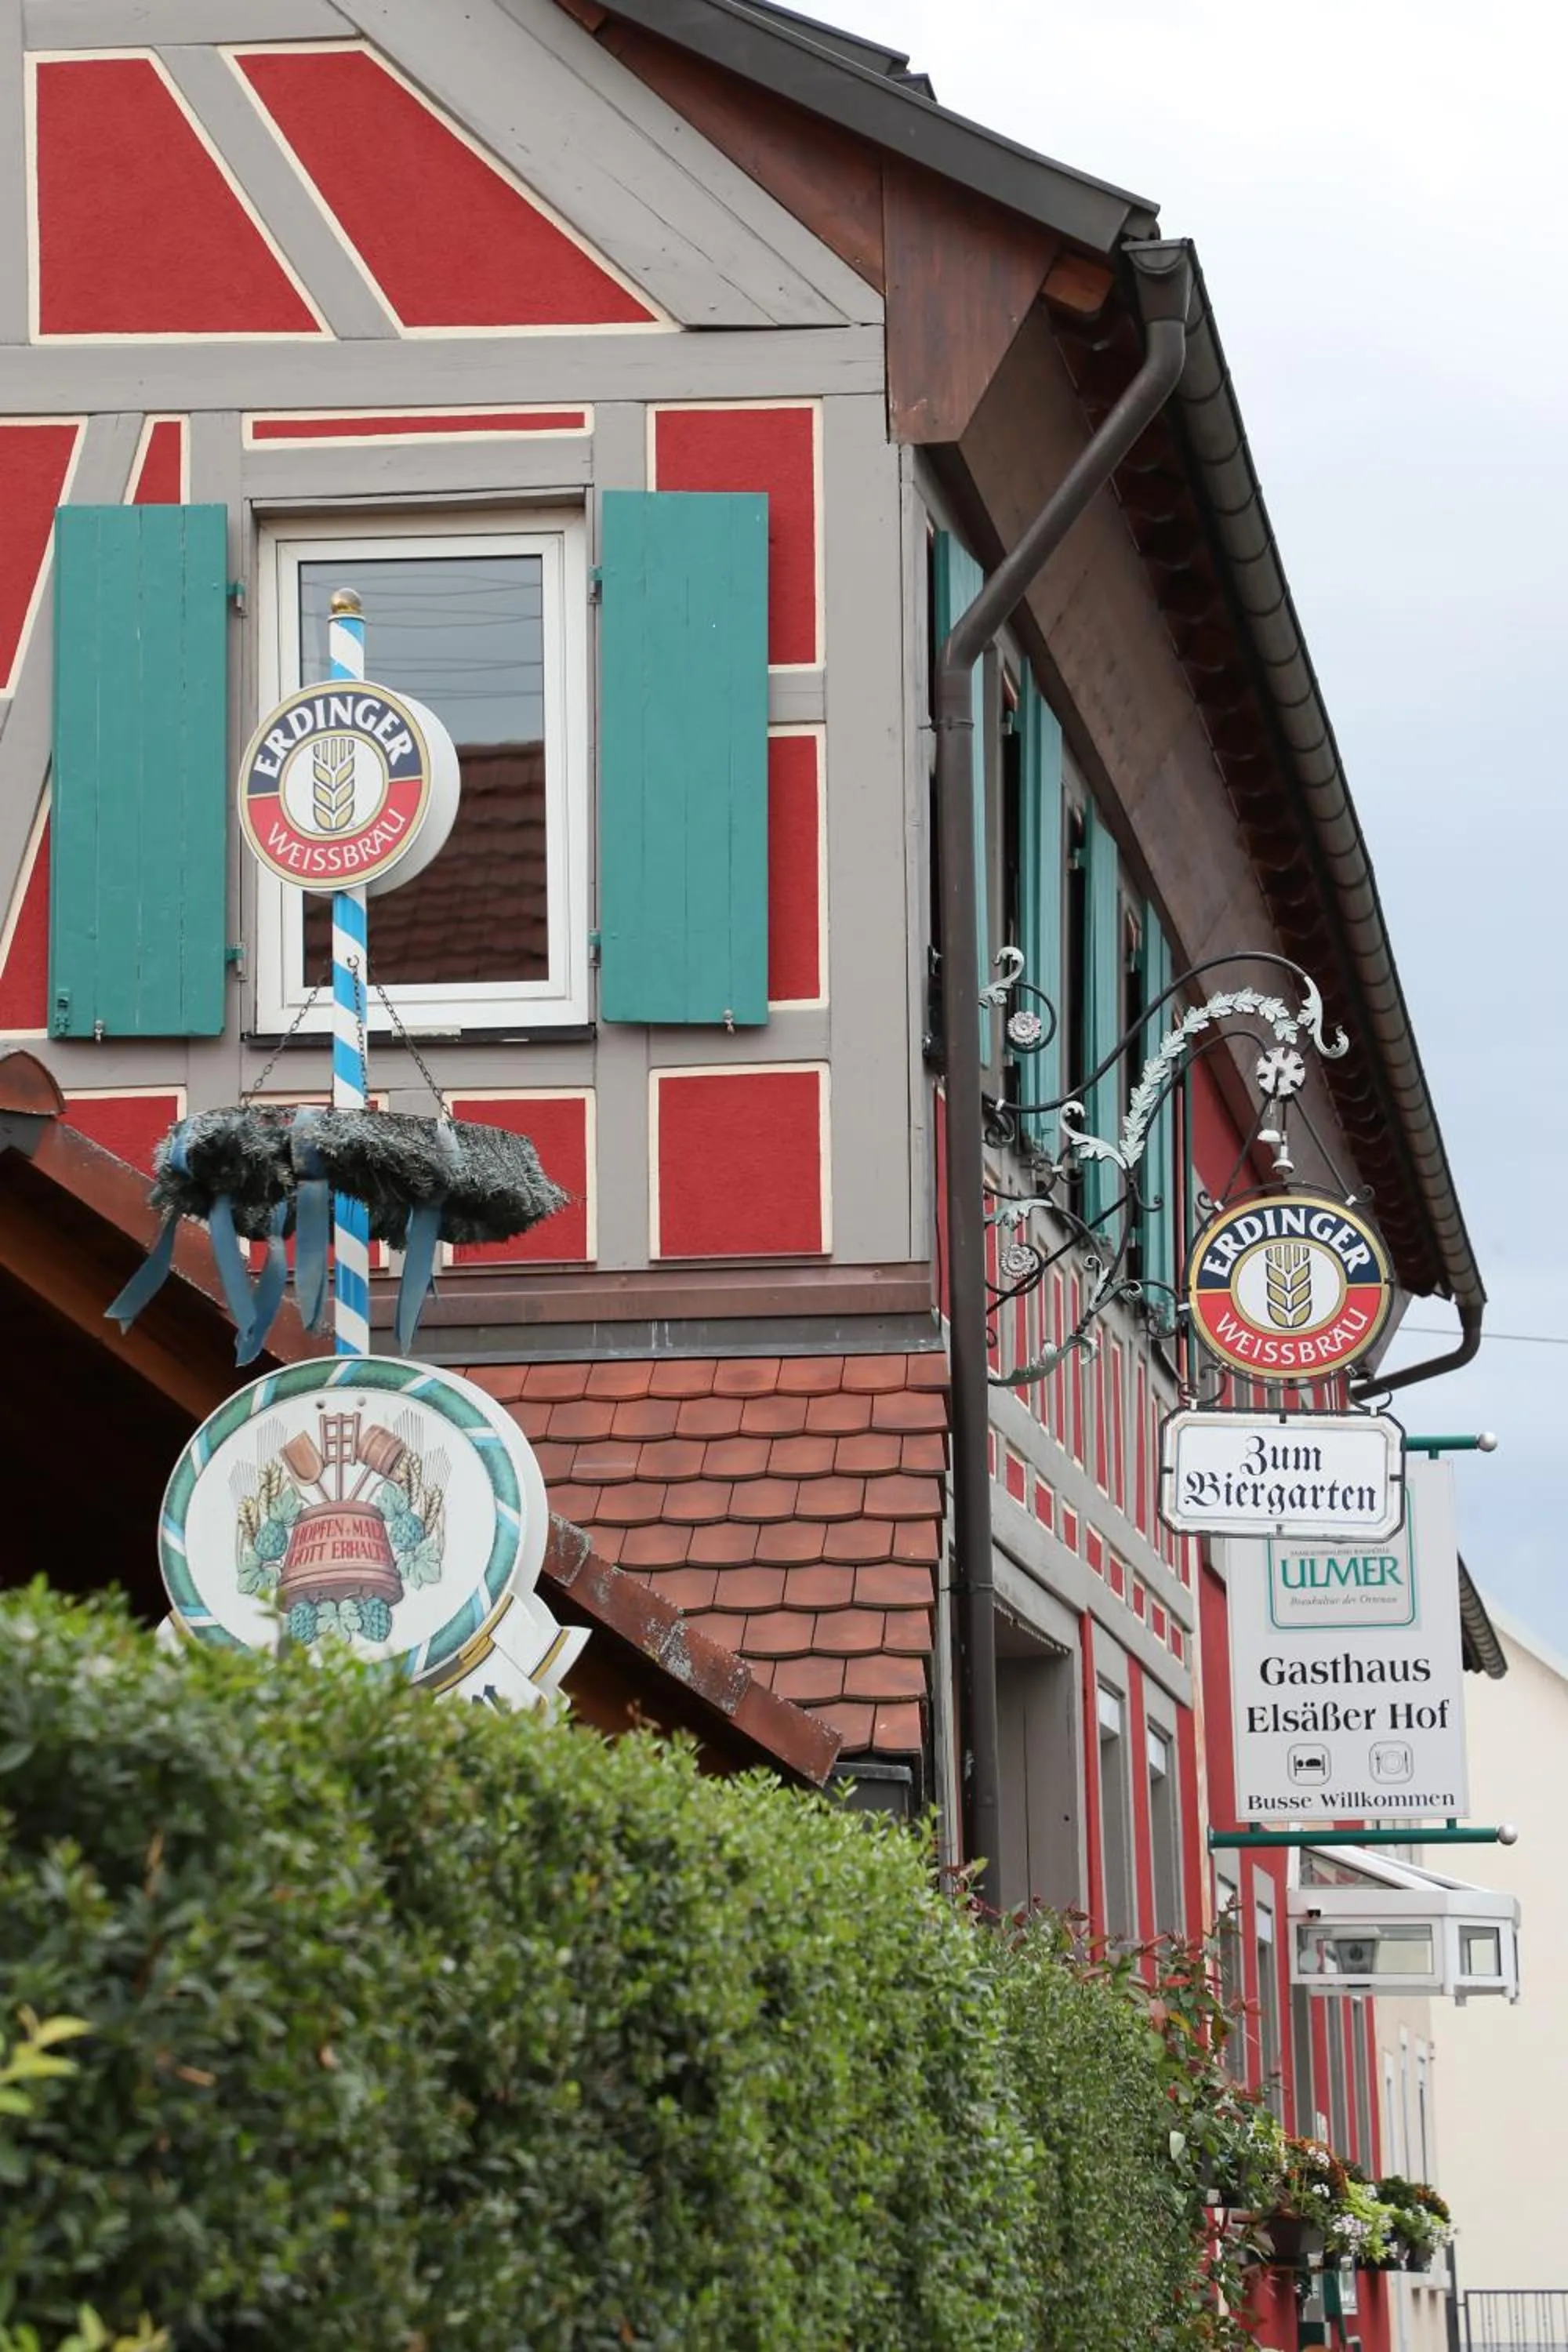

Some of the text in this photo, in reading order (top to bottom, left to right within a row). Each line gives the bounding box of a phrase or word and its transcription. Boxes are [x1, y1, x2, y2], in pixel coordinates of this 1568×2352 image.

[253, 696, 414, 779] ERDINGER
[267, 808, 406, 872] WEISSBRÄU
[1203, 1208, 1371, 1278] ERDINGER
[1216, 1308, 1368, 1364] WEISSBRÄU
[1240, 1436, 1322, 1475] Zum
[1183, 1471, 1377, 1515] Biergarten
[1281, 1555, 1403, 1588] ULMER
[1260, 1653, 1431, 1686] Gasthaus
[1247, 1699, 1450, 1733] Elsäßer Hof
[1248, 1791, 1455, 1810] Busse Willkommen
